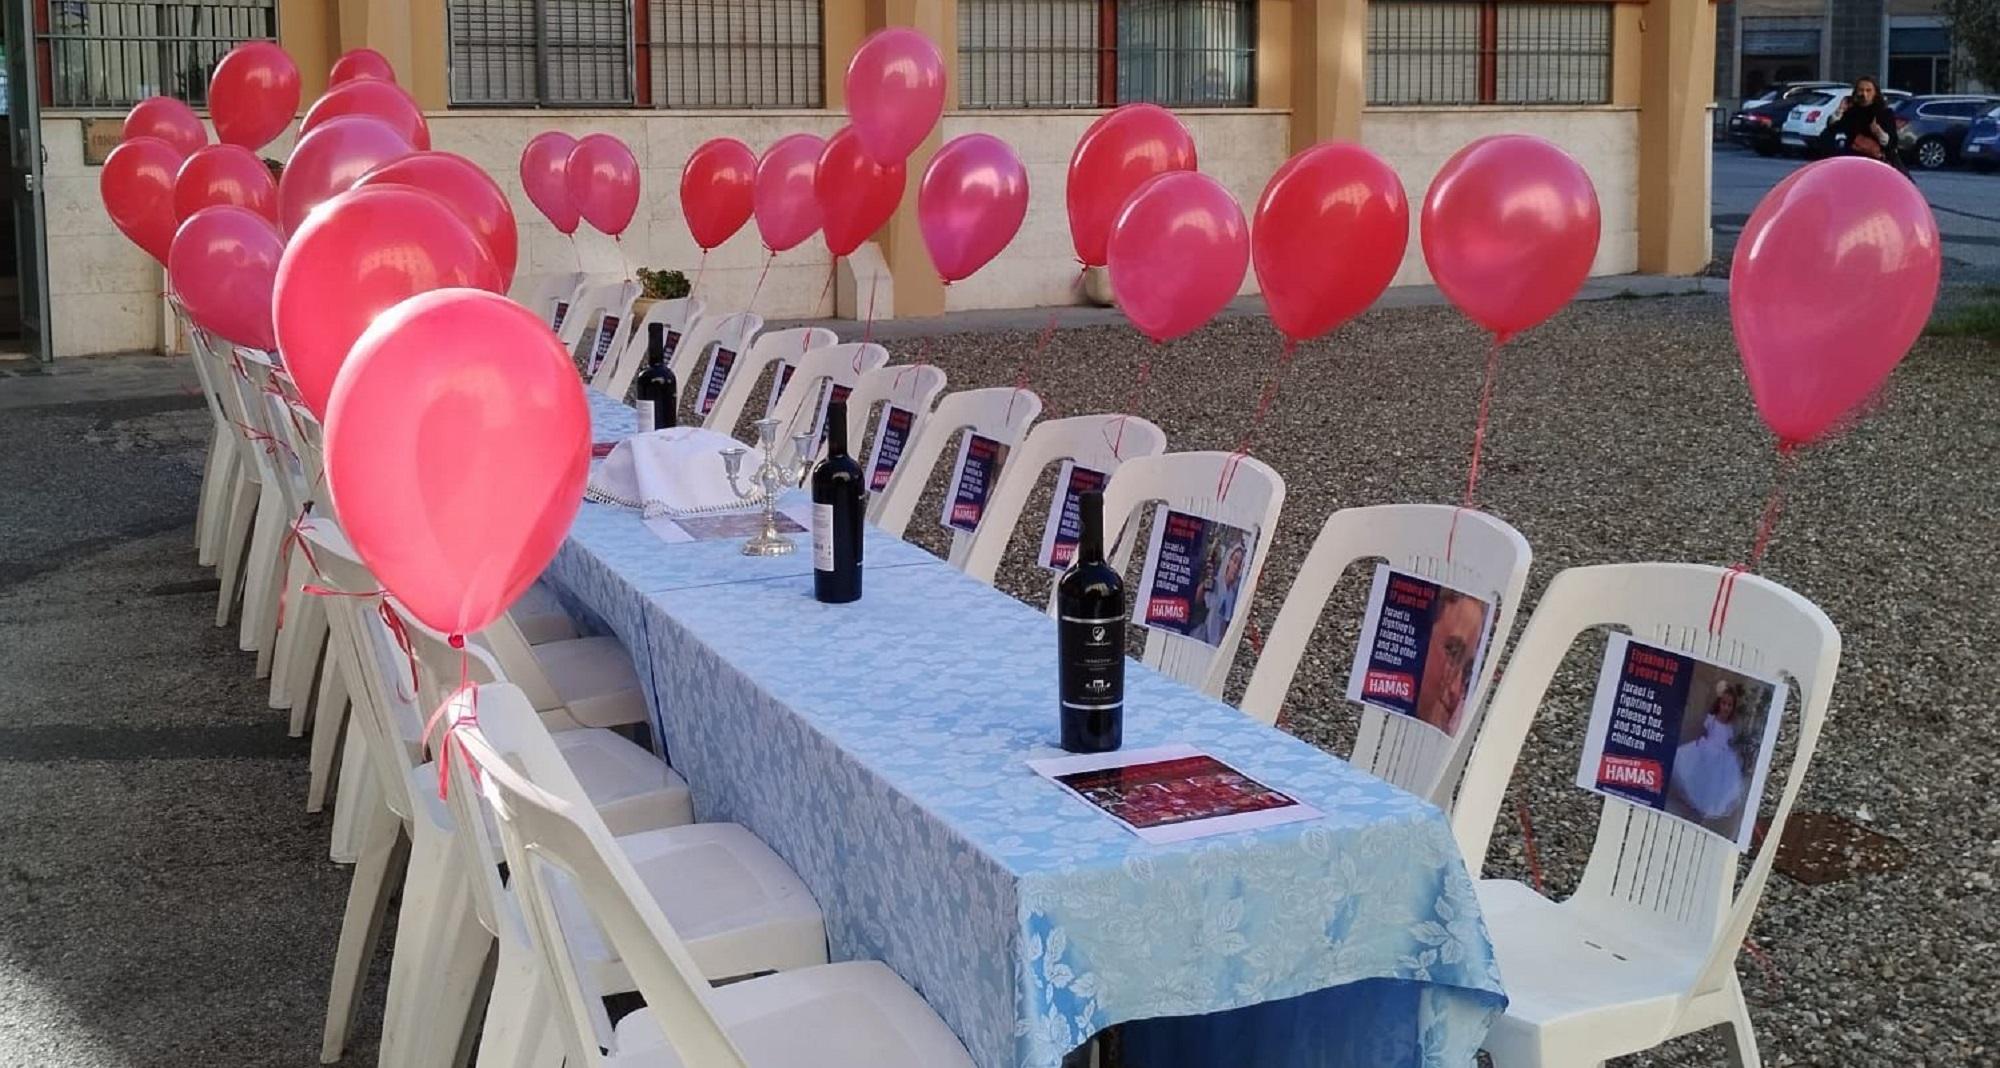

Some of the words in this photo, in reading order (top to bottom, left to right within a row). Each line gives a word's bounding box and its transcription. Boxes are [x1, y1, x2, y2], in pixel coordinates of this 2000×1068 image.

[1152, 605, 1184, 618] HAMAS
[1385, 607, 1404, 620] Israel
[1374, 651, 1401, 666] children
[1369, 679, 1409, 696] HAMAS
[1623, 680, 1647, 696] Israel
[1648, 687, 1655, 700] is
[1620, 694, 1652, 713] fighting
[1653, 703, 1662, 715] to
[1616, 707, 1647, 724] release
[1613, 720, 1629, 734] and
[1641, 727, 1664, 744] other
[1611, 732, 1646, 751] children
[1605, 764, 1655, 785] HAMAS
